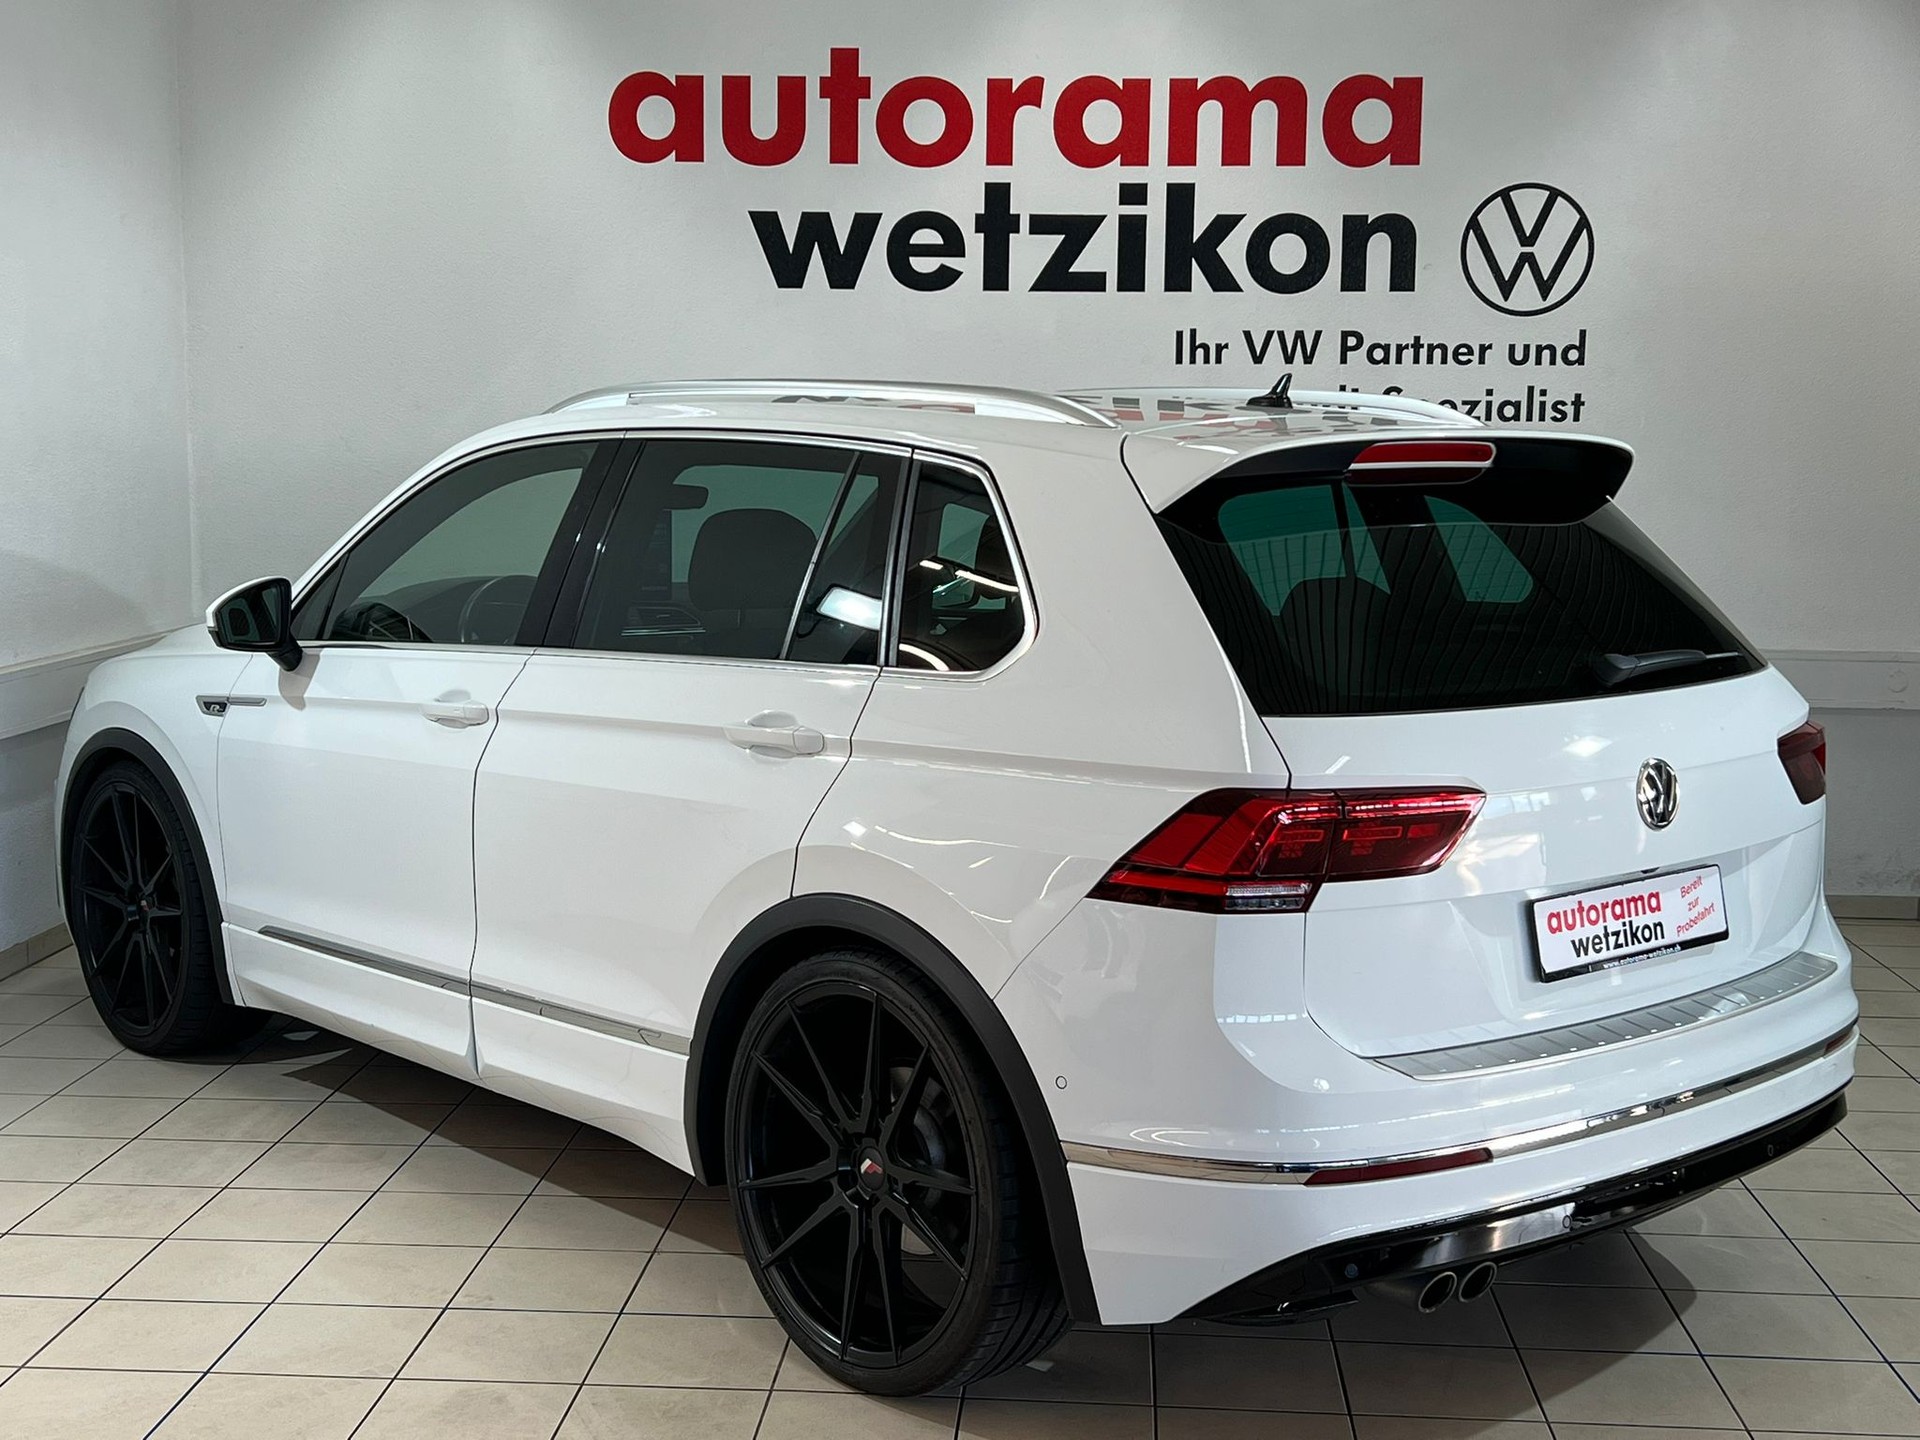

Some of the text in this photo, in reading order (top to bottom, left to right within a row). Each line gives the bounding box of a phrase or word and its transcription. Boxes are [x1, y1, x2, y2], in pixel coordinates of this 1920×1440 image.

[609, 48, 1423, 168] autorama
[748, 182, 1417, 294] wetzikon
[1175, 328, 1587, 366] Ihr VW Partner und
[1382, 385, 1586, 423] zialist
[1680, 876, 1703, 898] Bereit
[1687, 896, 1700, 912] zur
[1547, 891, 1662, 935] autorama
[1676, 902, 1715, 937] Probefahrt
[1570, 919, 1666, 958] wetzikon
